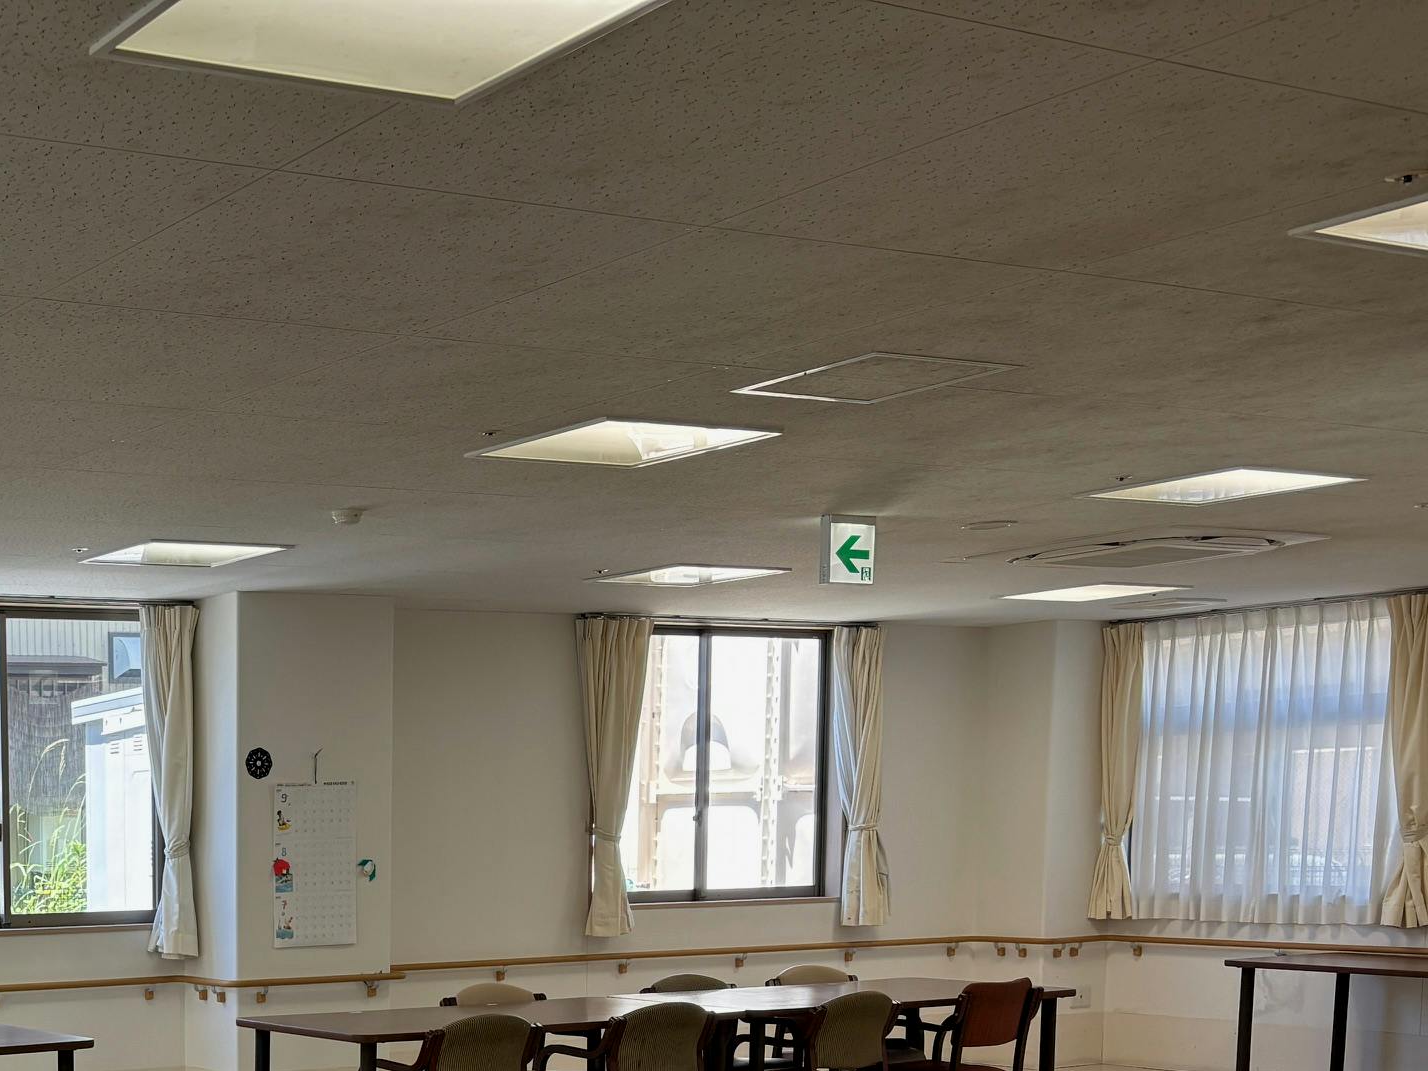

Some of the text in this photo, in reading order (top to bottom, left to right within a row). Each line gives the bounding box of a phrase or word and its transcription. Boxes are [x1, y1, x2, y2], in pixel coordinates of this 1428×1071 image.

[280, 793, 288, 803] 9
[281, 847, 287, 857] 8
[281, 900, 288, 910] 7
